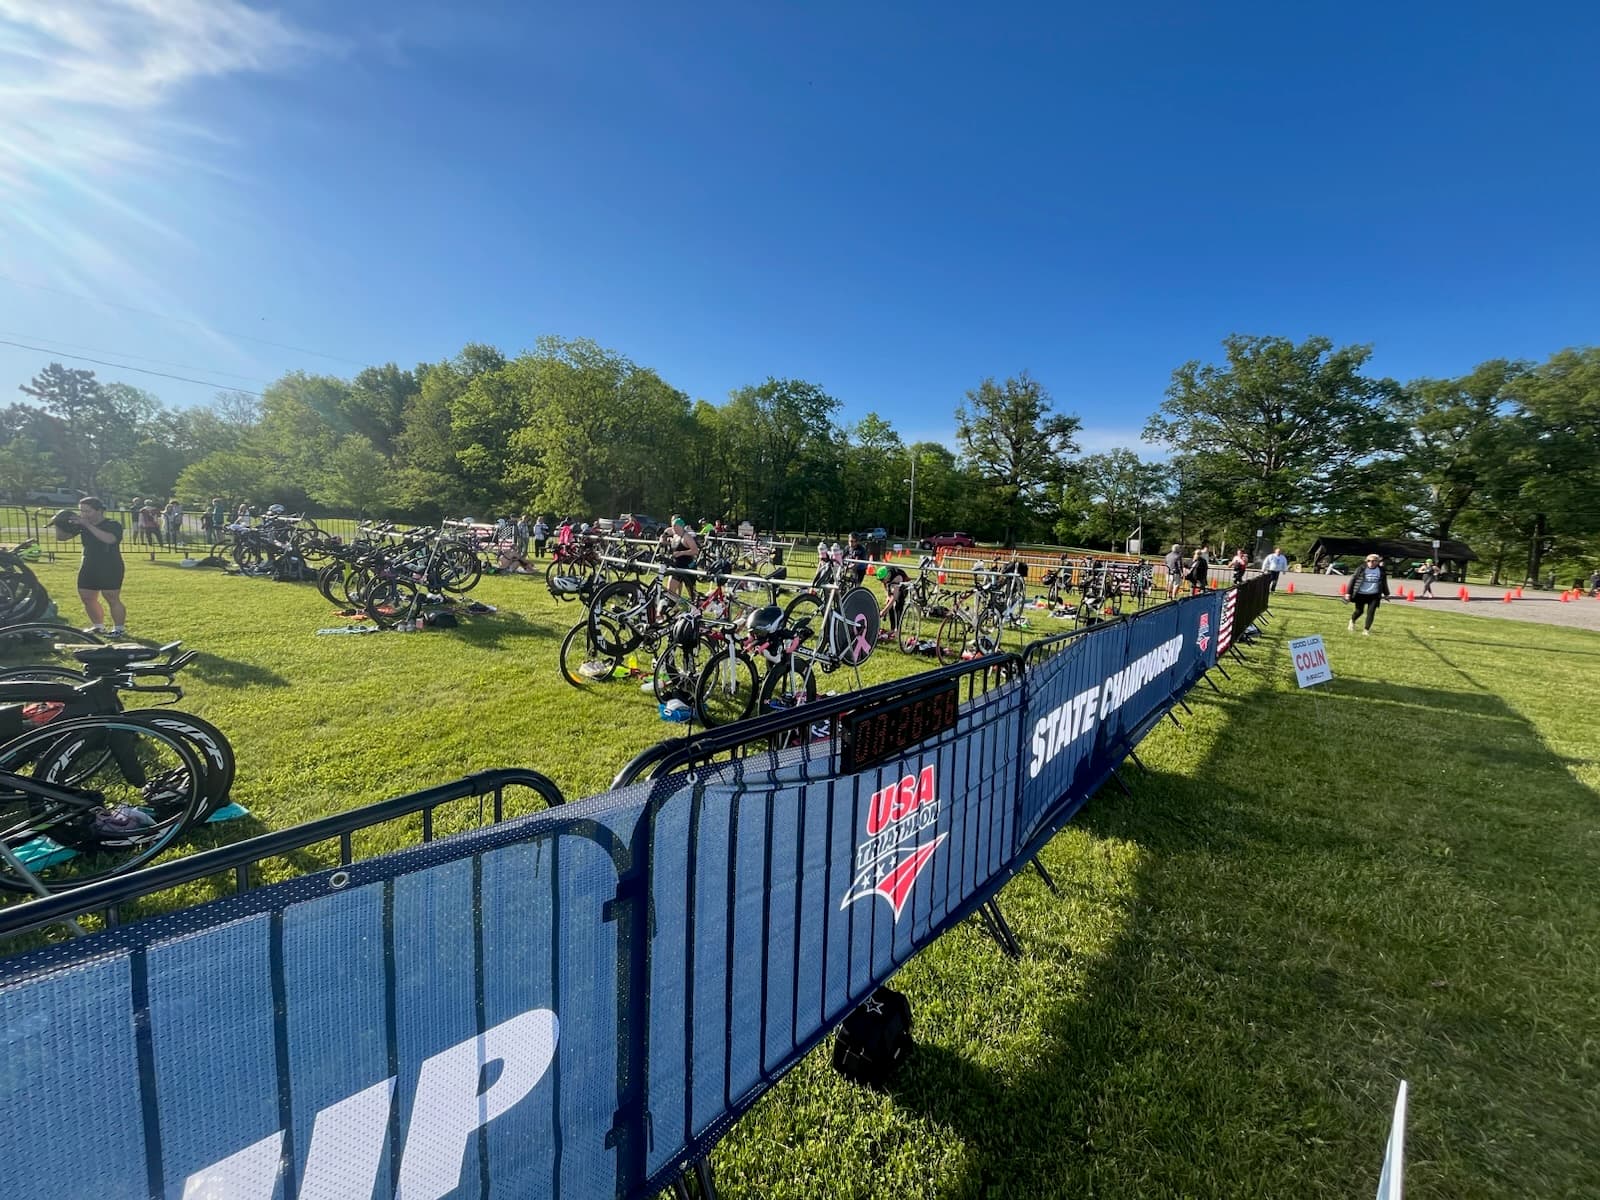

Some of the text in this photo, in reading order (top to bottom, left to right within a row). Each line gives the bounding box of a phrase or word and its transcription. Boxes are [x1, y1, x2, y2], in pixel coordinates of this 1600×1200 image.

[1296, 649, 1326, 671] COLIN
[1030, 634, 1184, 778] STATE CHAMPIONSHIP
[857, 799, 941, 870] TRIATHLON
[866, 764, 934, 836] USA
